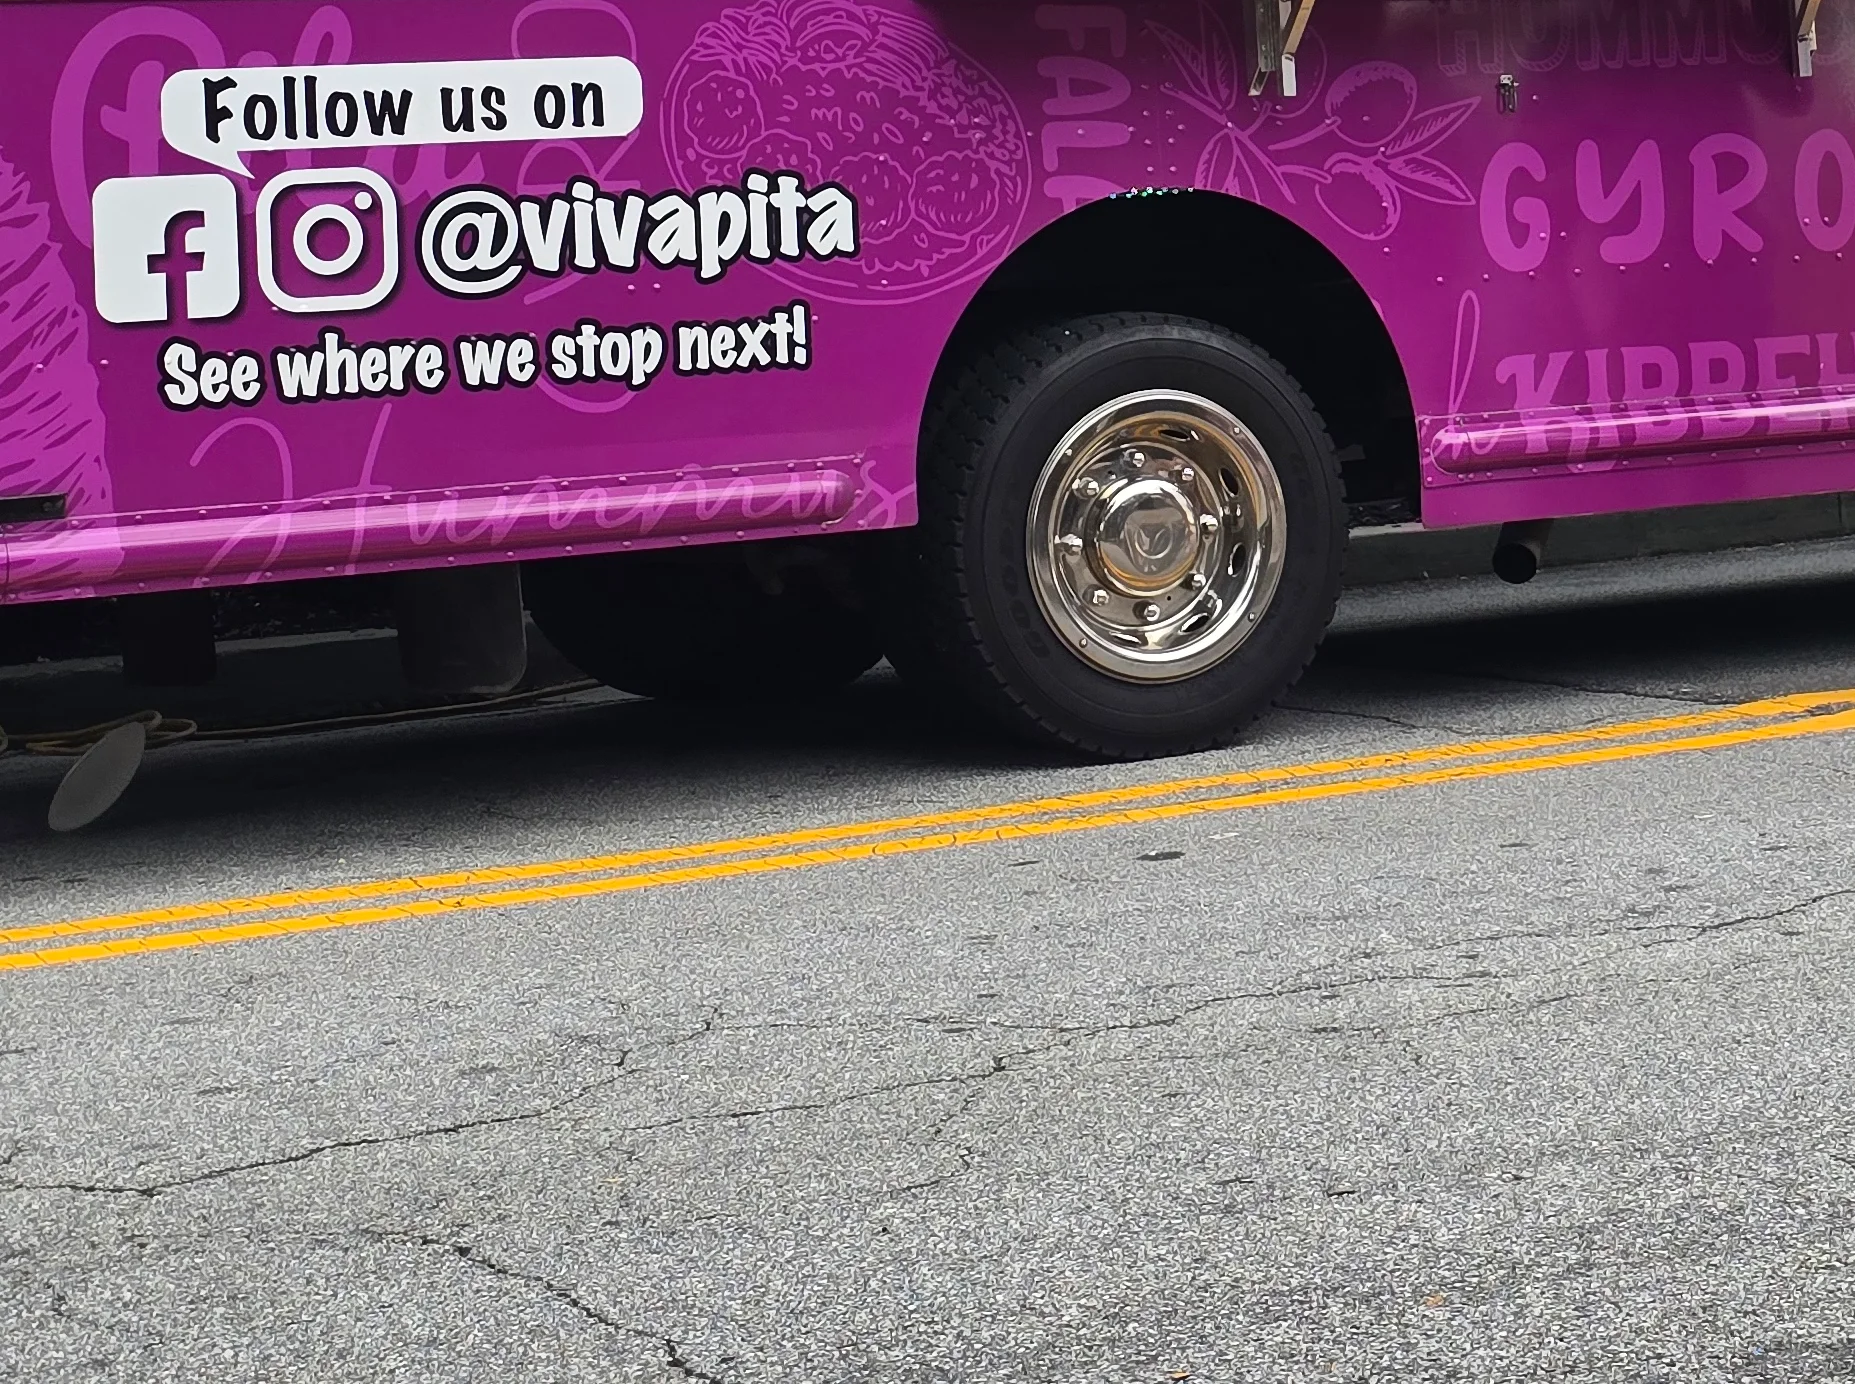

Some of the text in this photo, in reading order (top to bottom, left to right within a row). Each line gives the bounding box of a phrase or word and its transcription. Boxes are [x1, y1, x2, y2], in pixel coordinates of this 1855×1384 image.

[203, 73, 606, 145] Follow us on
[421, 172, 854, 294] @vivapita
[164, 306, 807, 407] See where we stop next!
[189, 402, 917, 590] Hummus
